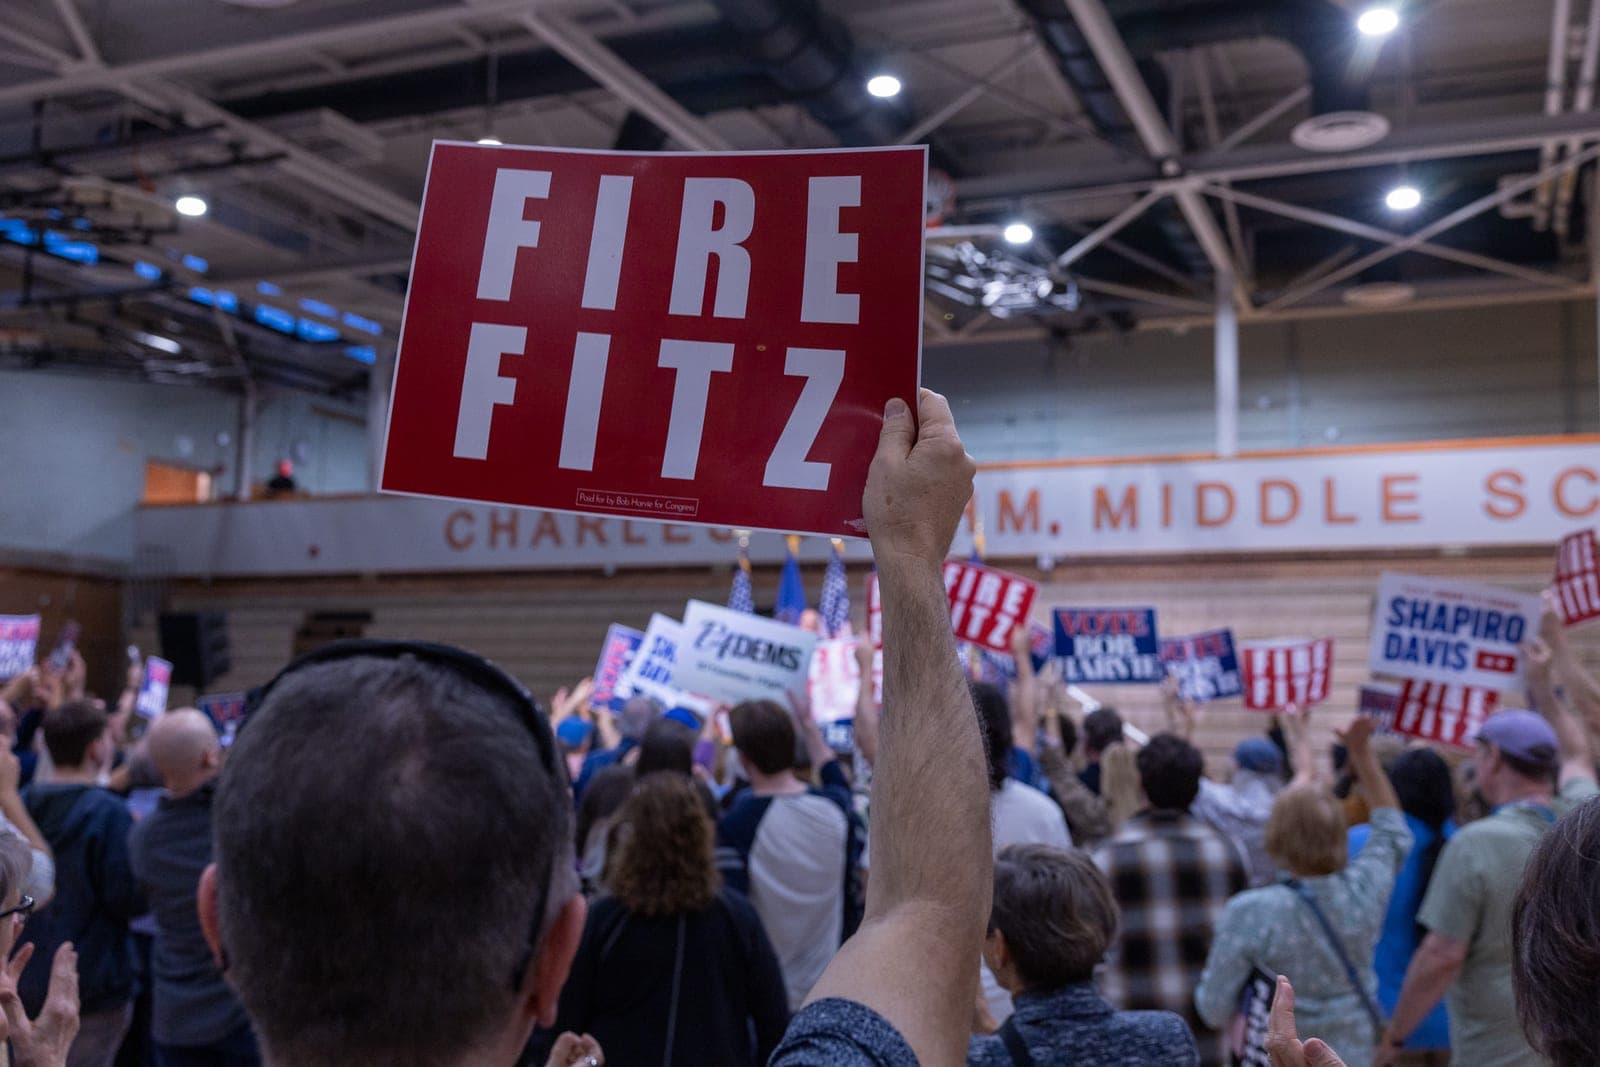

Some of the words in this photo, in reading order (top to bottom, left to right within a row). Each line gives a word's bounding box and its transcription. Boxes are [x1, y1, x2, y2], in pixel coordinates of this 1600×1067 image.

[476, 167, 862, 324] FIRE
[453, 322, 846, 492] FITZ
[580, 492, 595, 502] Paid
[596, 494, 605, 504] for
[606, 495, 614, 506] by
[616, 496, 630, 506] Bob
[631, 498, 654, 508] Harvie
[655, 499, 664, 509] for
[665, 500, 696, 513] Congress
[1092, 475, 1422, 531] MIDDLE
[944, 564, 1027, 615] FIRE
[952, 602, 1014, 648] ITZ
[1060, 611, 1148, 637] VOTE
[1388, 597, 1526, 644] SHAPIRO
[1384, 633, 1469, 671] DAVIS
